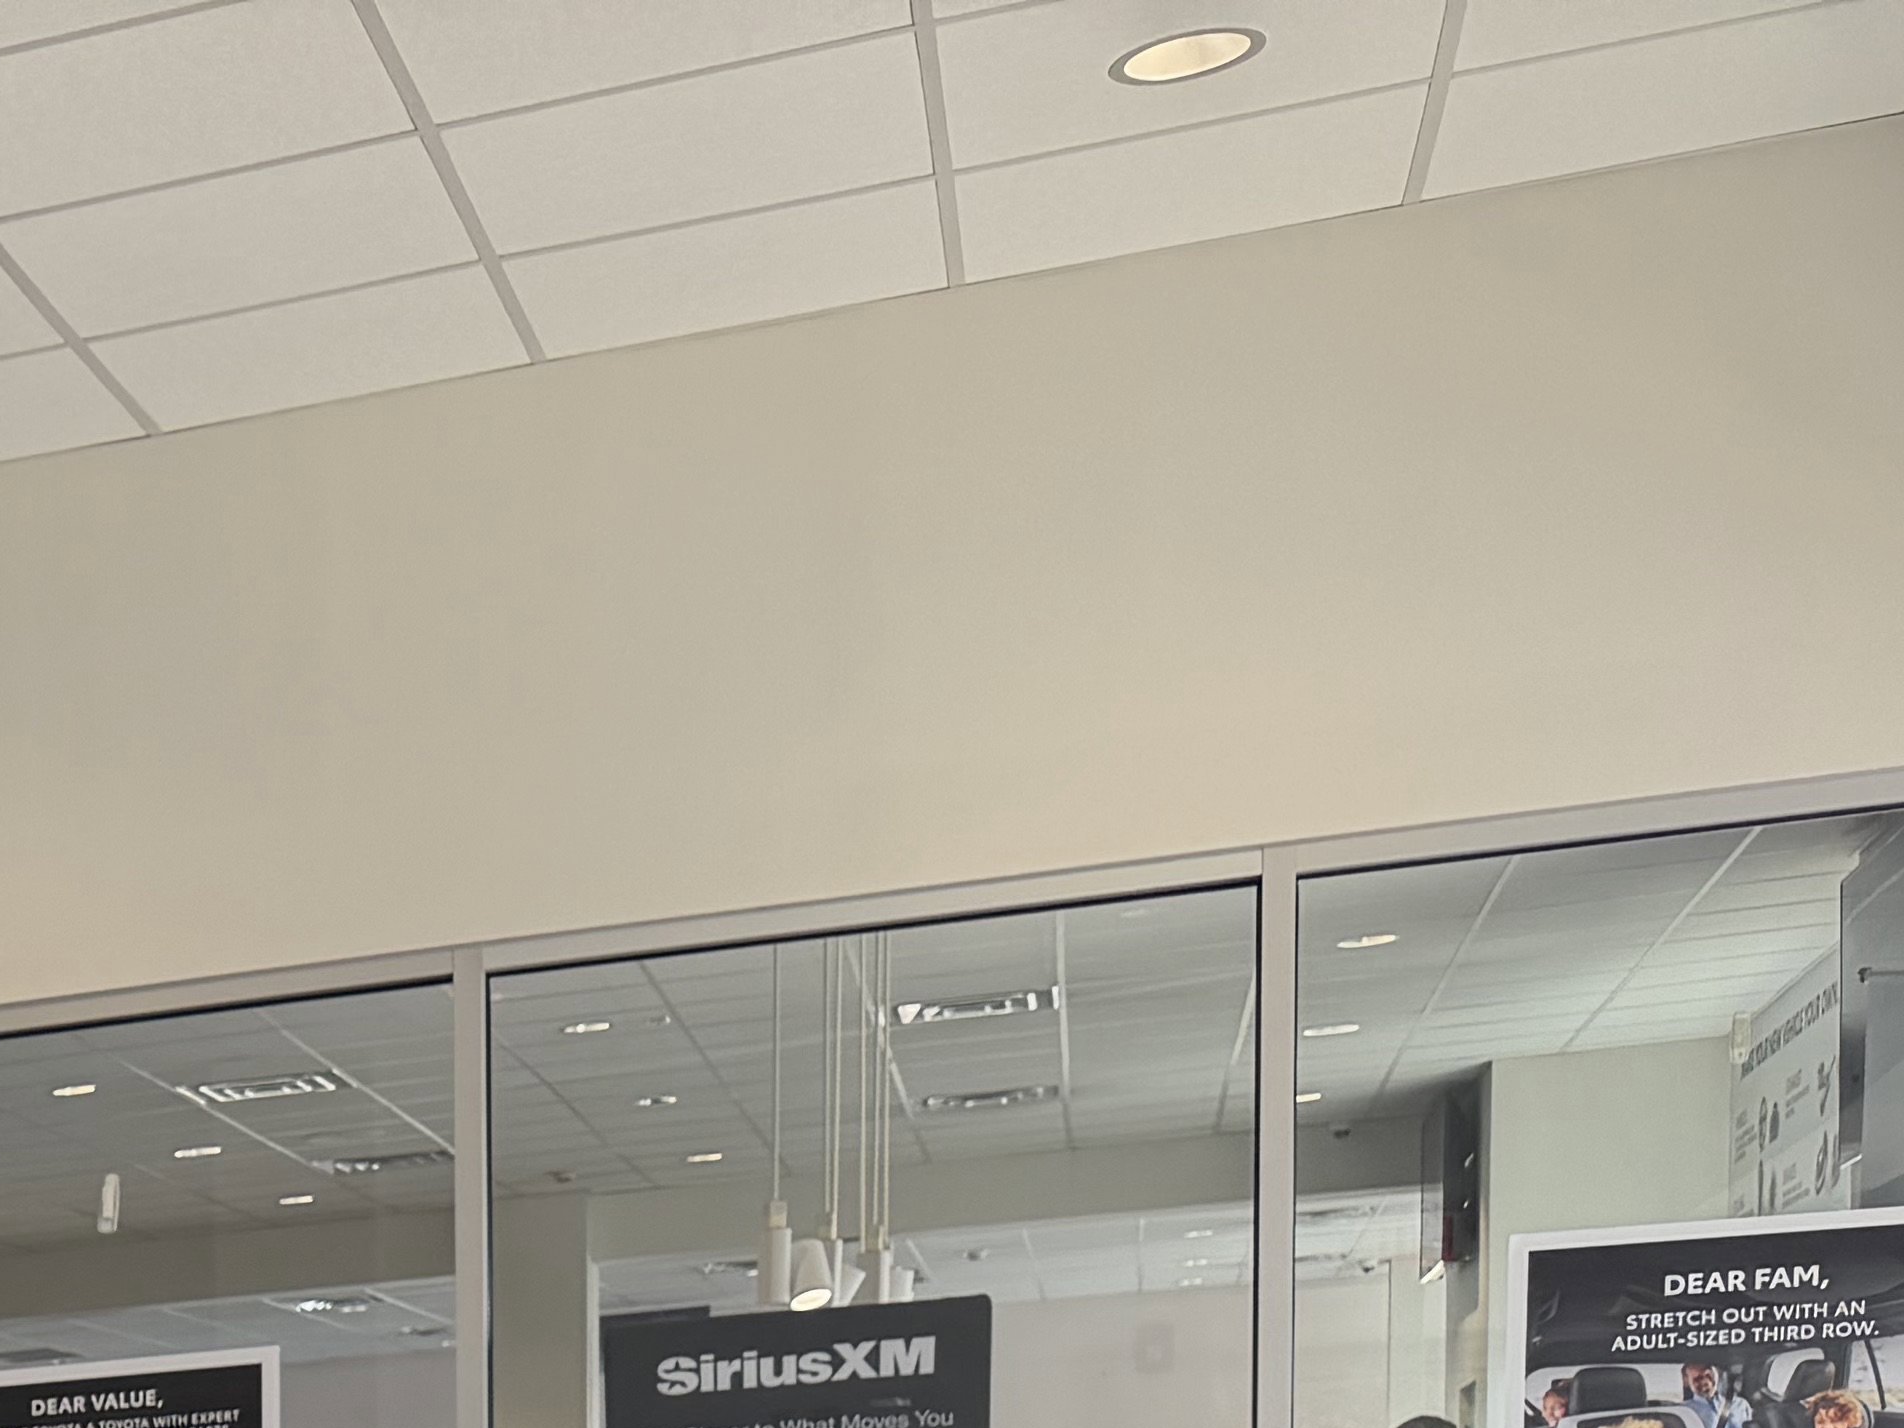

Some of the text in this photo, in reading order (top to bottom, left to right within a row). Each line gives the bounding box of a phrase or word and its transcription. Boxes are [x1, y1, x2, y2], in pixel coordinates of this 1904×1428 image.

[1664, 1264, 1829, 1296] DEAR FAM,
[1626, 1300, 1866, 1331] STRETCH OUT WITH AN
[1611, 1320, 1879, 1351] ADULT-SIZED THIRD ROW.
[656, 1335, 937, 1396] SiriusXM
[31, 1389, 164, 1417] DEAR VALUE,
[152, 1414, 188, 1428] WITH
[192, 1409, 240, 1425] EXPERT
[915, 1408, 955, 1428] You
